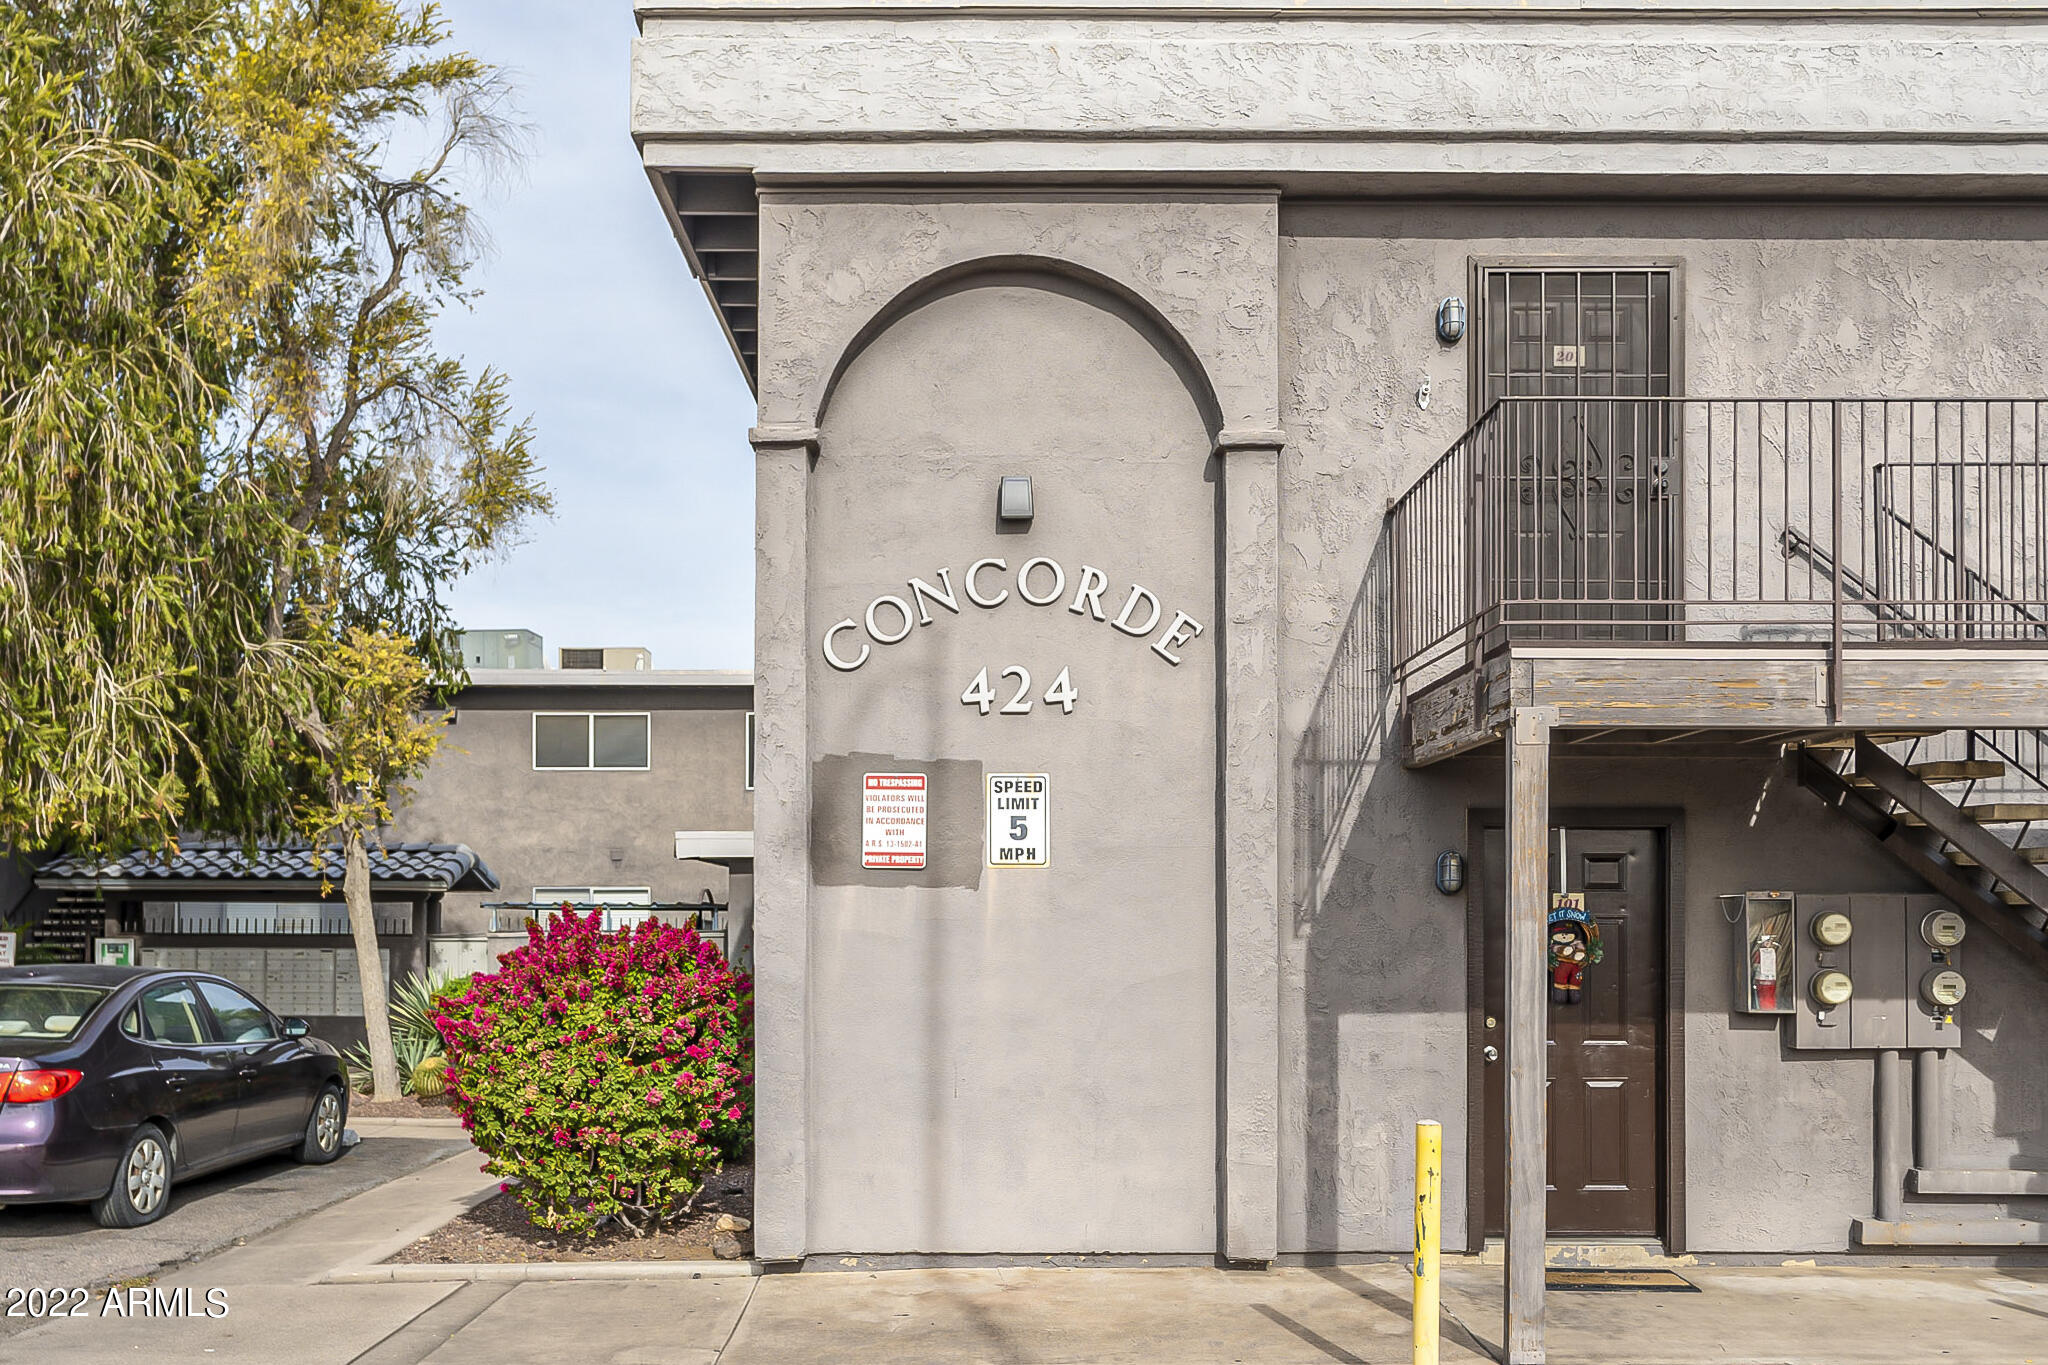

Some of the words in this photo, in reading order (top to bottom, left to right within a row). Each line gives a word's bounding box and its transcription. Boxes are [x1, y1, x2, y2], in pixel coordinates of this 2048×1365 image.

[822, 556, 1204, 672] CONCORDE
[961, 665, 1078, 716] 424
[994, 780, 1043, 794] SPEED
[865, 794, 906, 802] VIOLATORS
[907, 794, 925, 802] WILL
[997, 797, 1040, 810] LIMIT
[866, 805, 875, 813] BE
[877, 805, 925, 814] PROSECUTED
[865, 817, 874, 825] IN
[875, 817, 925, 825] ACCORDANCE
[885, 828, 905, 836] WITH
[1009, 815, 1028, 841] 5
[999, 847, 1036, 861] MPH
[1557, 898, 1579, 908] 101
[1558, 909, 1565, 918] IT
[1566, 909, 1586, 920] SNOW
